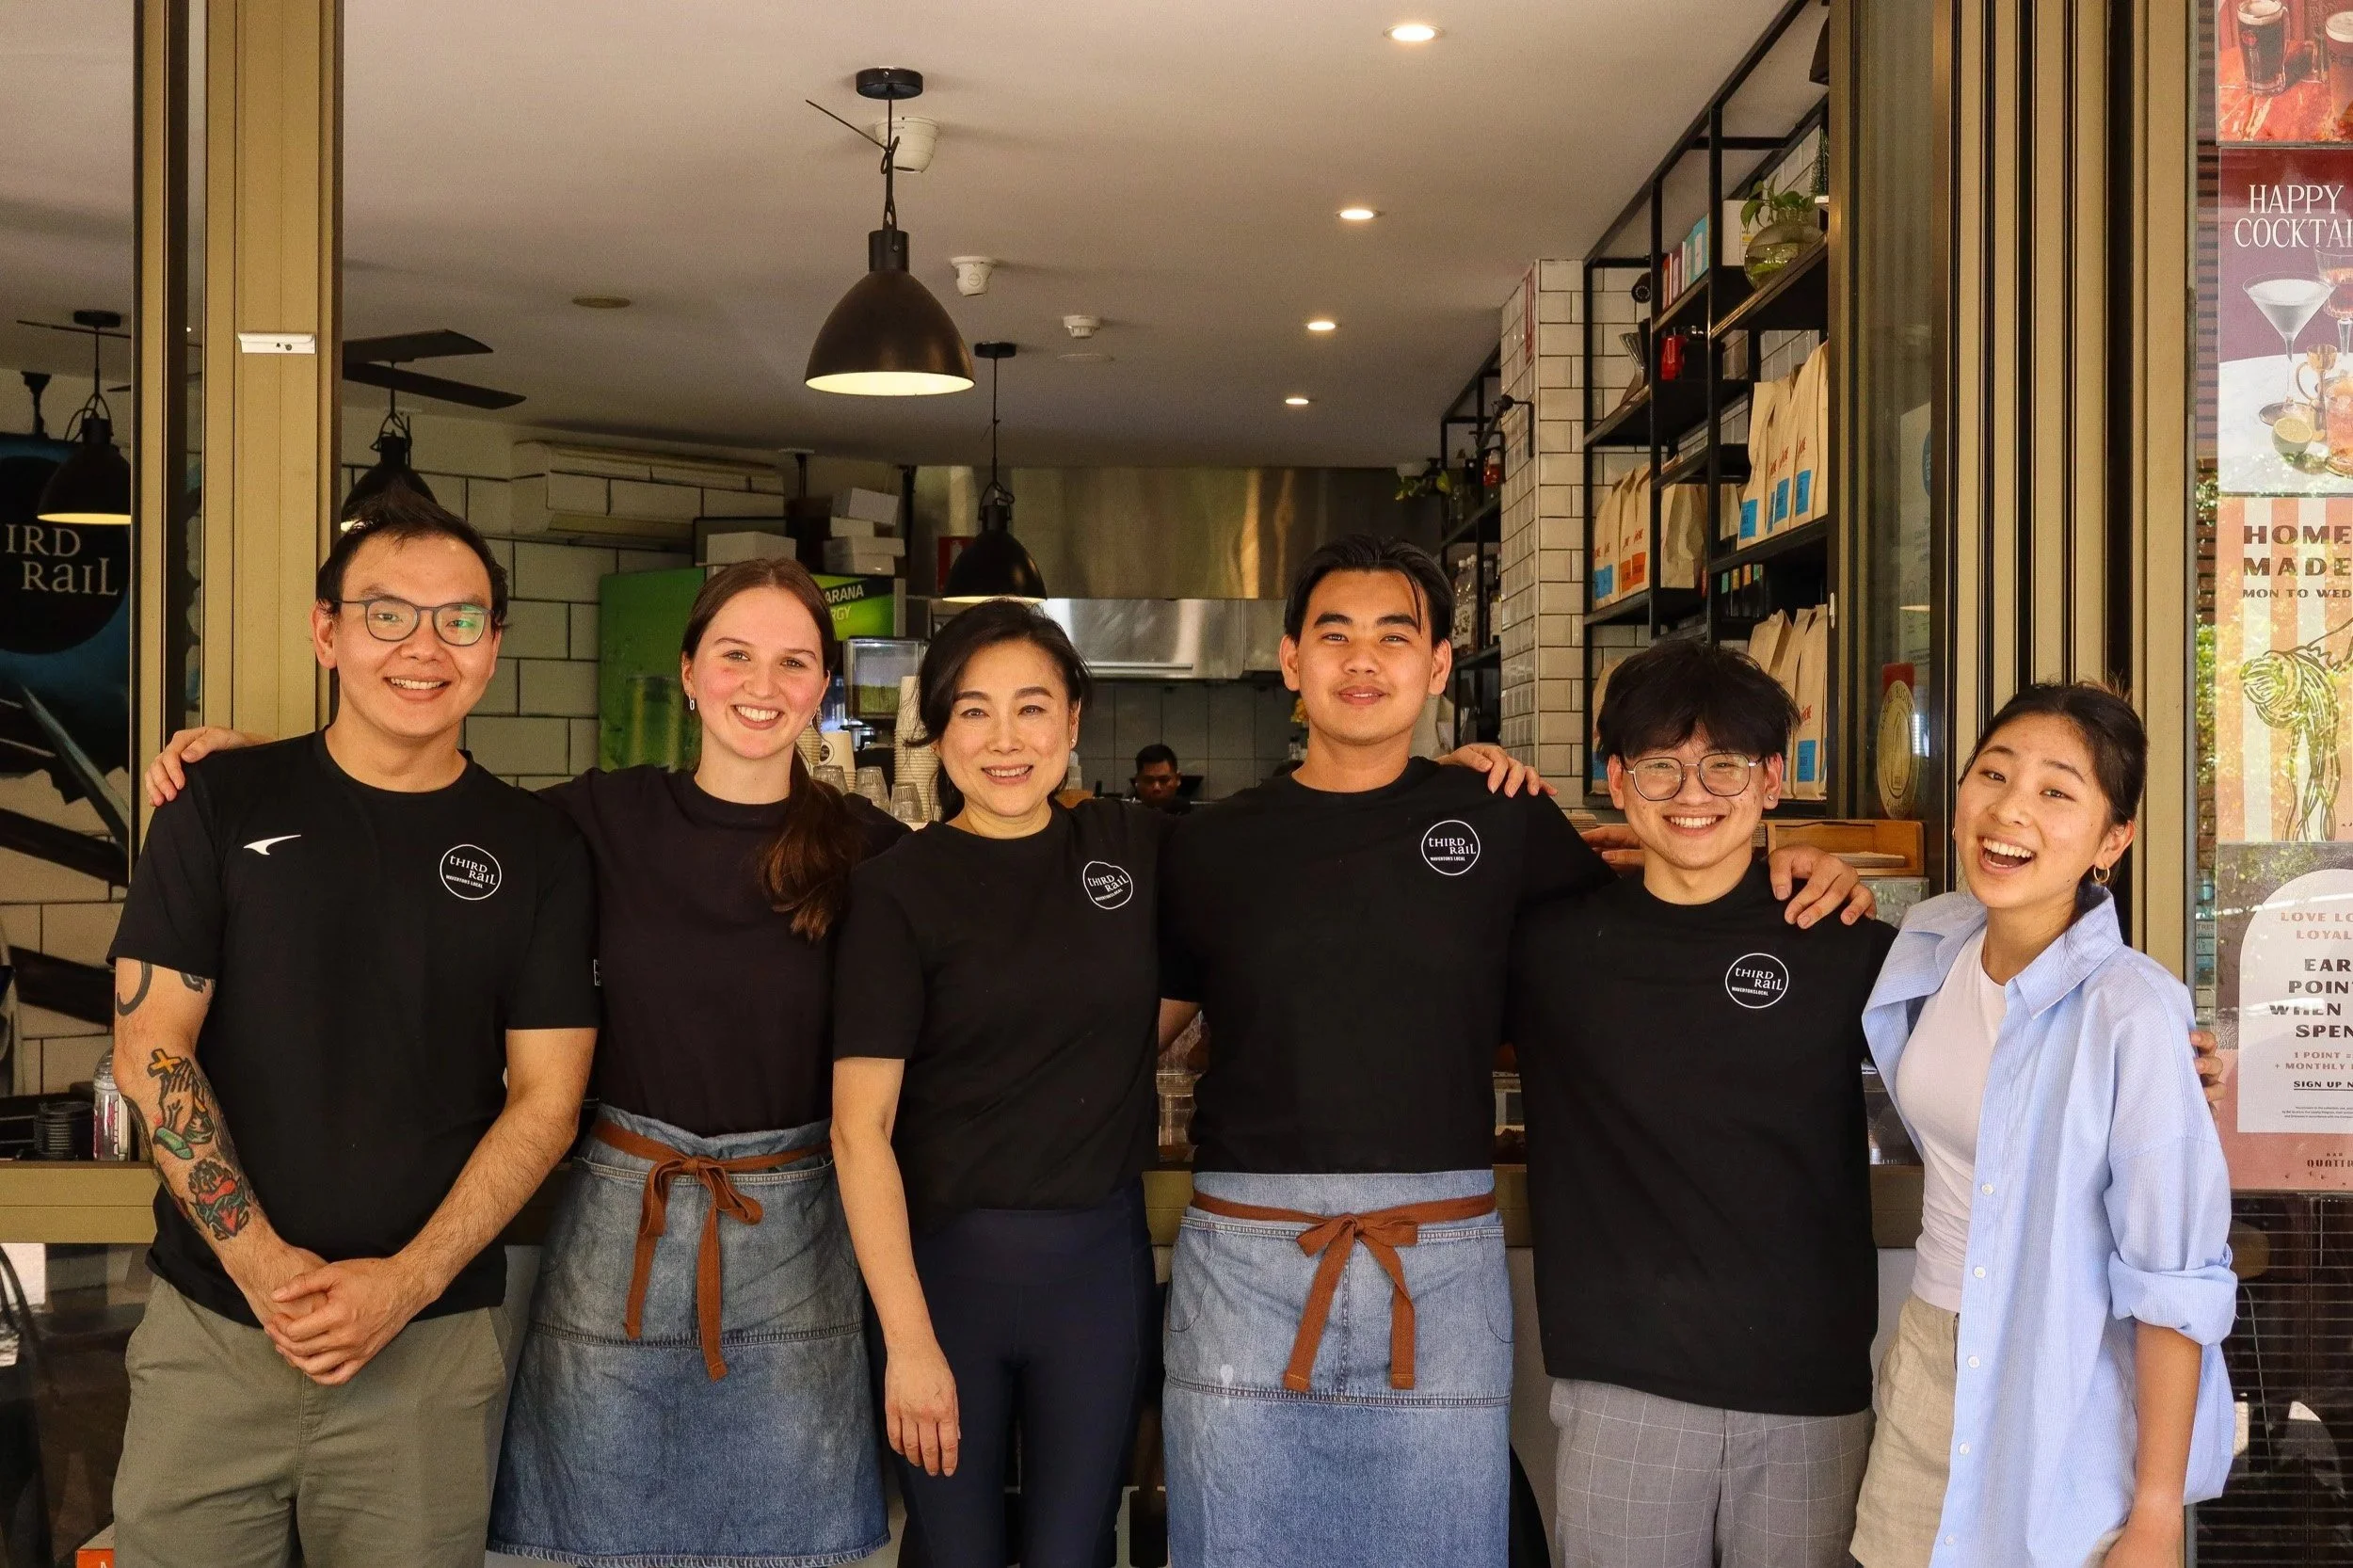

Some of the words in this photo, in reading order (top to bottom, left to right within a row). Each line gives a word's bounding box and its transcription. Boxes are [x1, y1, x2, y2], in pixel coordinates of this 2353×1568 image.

[2249, 184, 2345, 215] HAPPY
[2233, 217, 2353, 248] COCKTAI
[5, 523, 82, 557] IRD
[2243, 525, 2352, 544] HOME
[2243, 557, 2351, 576] MADE
[2243, 588, 2279, 599] MON
[2286, 588, 2309, 599] TO
[2316, 588, 2352, 599] WED
[2281, 912, 2327, 922] LOVE
[2304, 958, 2352, 972] EAR
[2288, 980, 2353, 994] POIN
